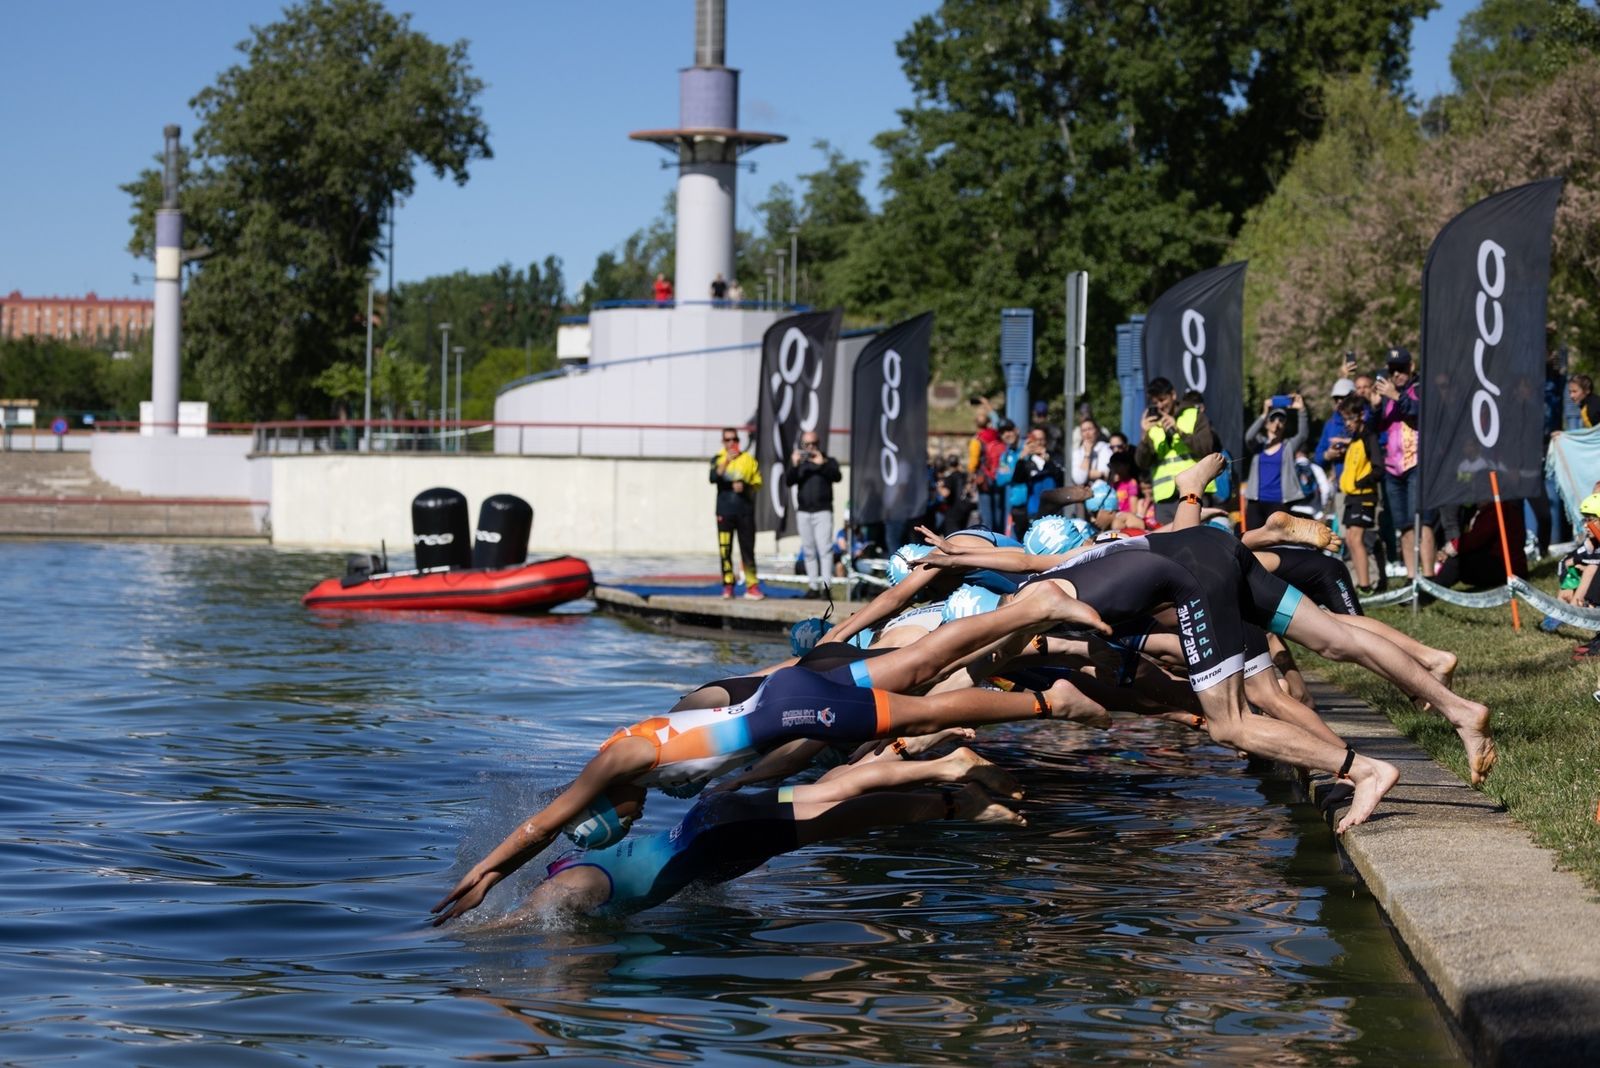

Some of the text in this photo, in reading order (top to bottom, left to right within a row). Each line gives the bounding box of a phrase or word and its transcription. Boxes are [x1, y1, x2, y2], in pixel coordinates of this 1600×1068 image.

[1181, 308, 1208, 394] ca
[1471, 239, 1506, 448] orca
[880, 349, 902, 486] orca
[1177, 604, 1201, 665] BREATHE
[1190, 598, 1213, 659] SPORT
[1197, 667, 1222, 683] VIATOR
[1244, 664, 1258, 674] ATOR
